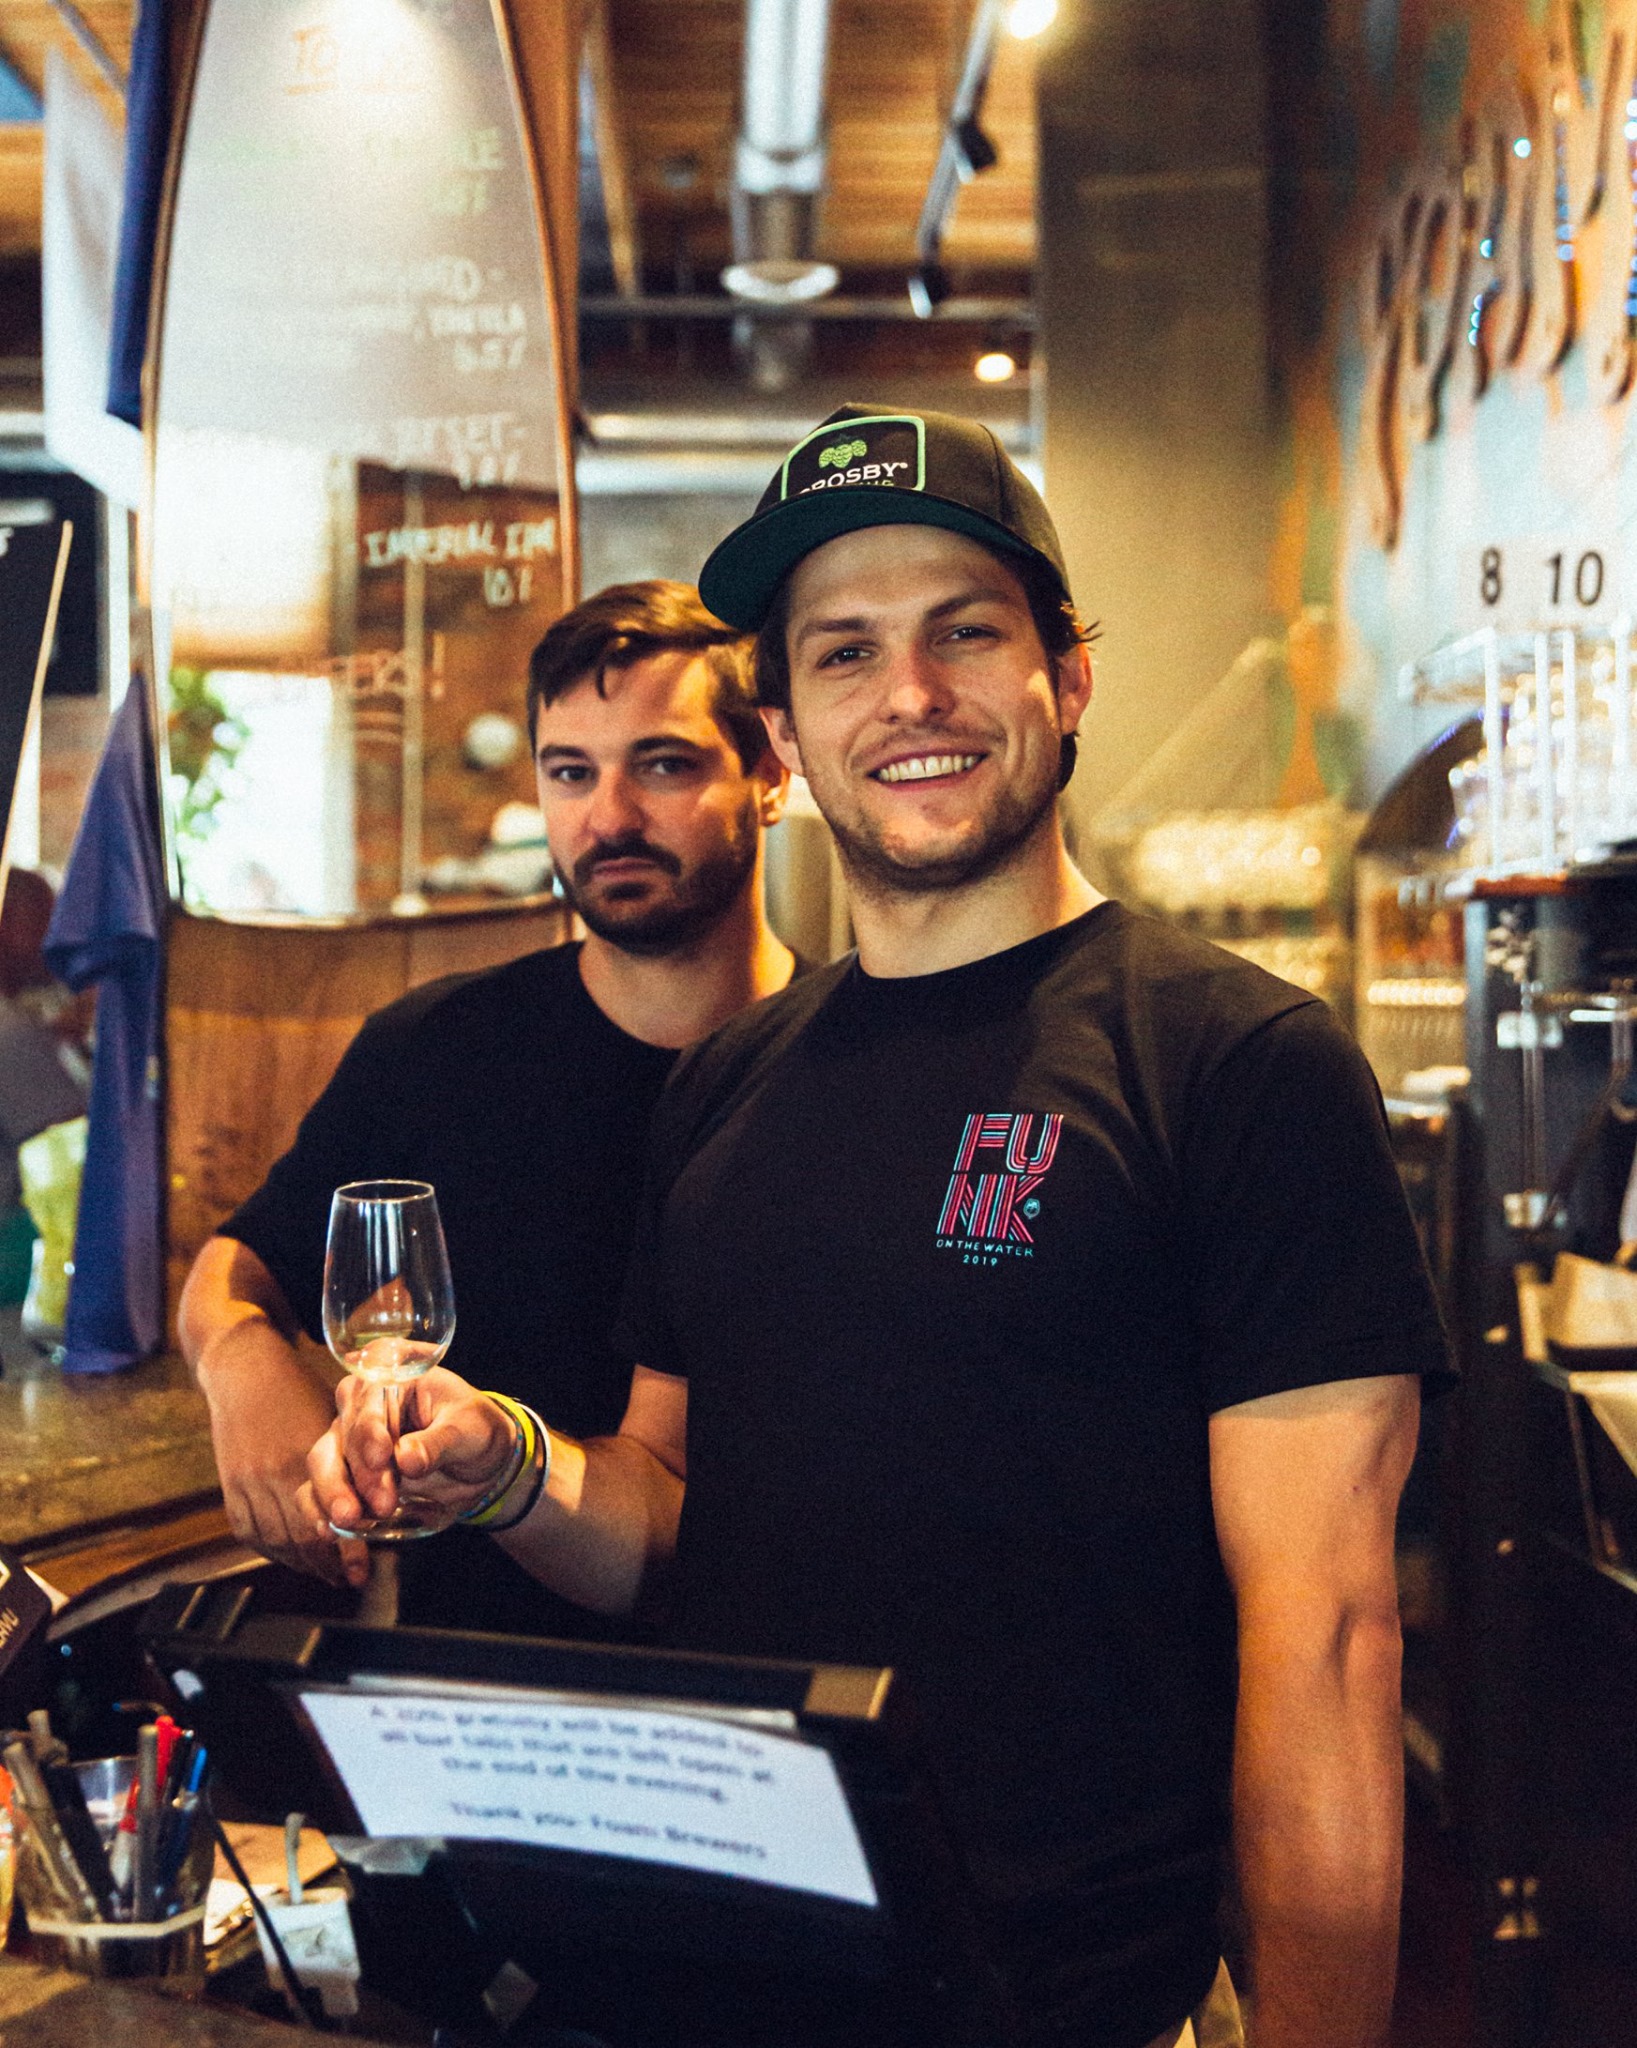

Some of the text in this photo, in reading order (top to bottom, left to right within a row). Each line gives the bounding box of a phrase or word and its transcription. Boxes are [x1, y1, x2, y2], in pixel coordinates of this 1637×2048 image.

[800, 462, 902, 494] ROSBY
[1480, 547, 1603, 607] 8 10
[936, 1239, 1034, 1257] ON THE WATER
[963, 1254, 998, 1266] 2019
